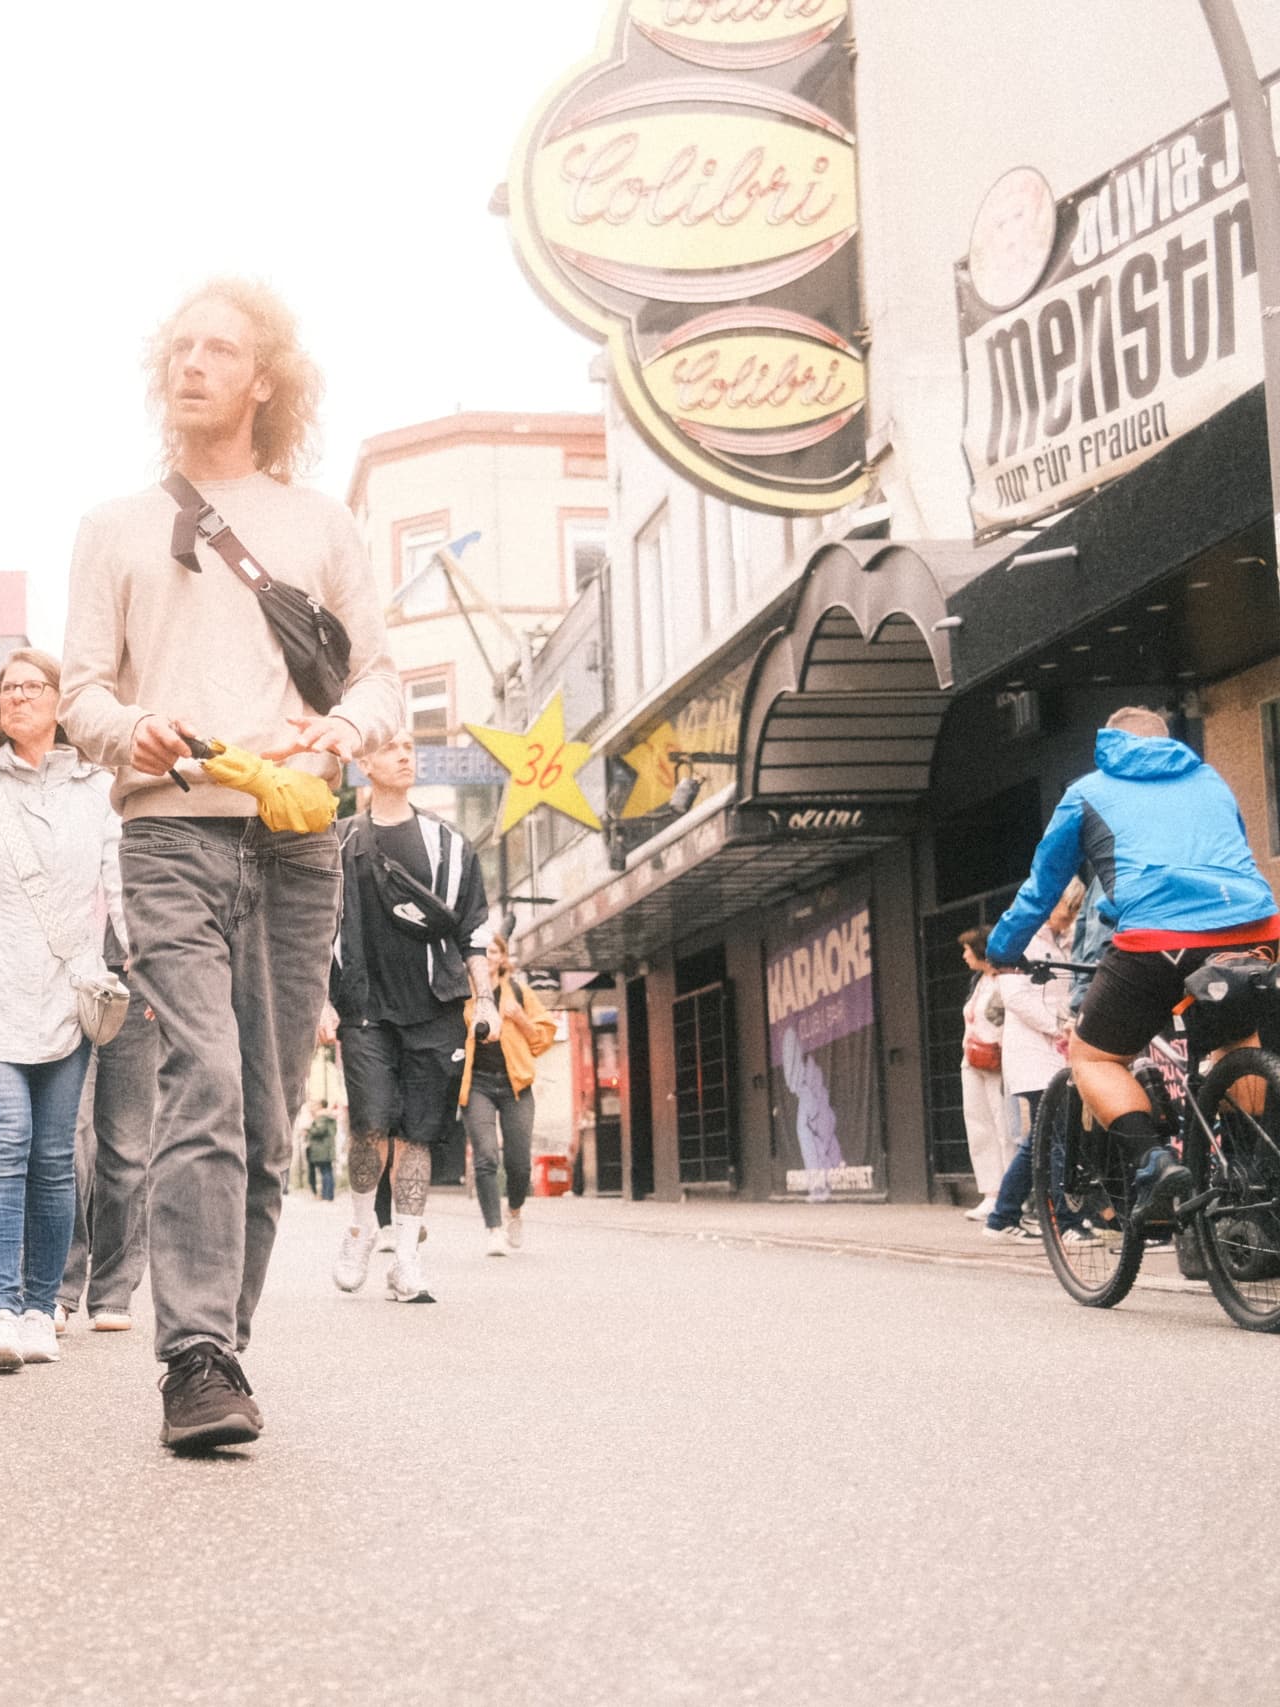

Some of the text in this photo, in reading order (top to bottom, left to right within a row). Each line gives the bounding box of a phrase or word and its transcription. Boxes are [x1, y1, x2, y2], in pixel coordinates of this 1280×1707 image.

[559, 132, 839, 227] Colibri
[986, 200, 1258, 467] menstr
[672, 348, 847, 412] Colibri
[995, 464, 1029, 508] nur
[1033, 442, 1071, 492] für
[514, 742, 565, 790] 36
[767, 908, 874, 1026] KARAOKE
